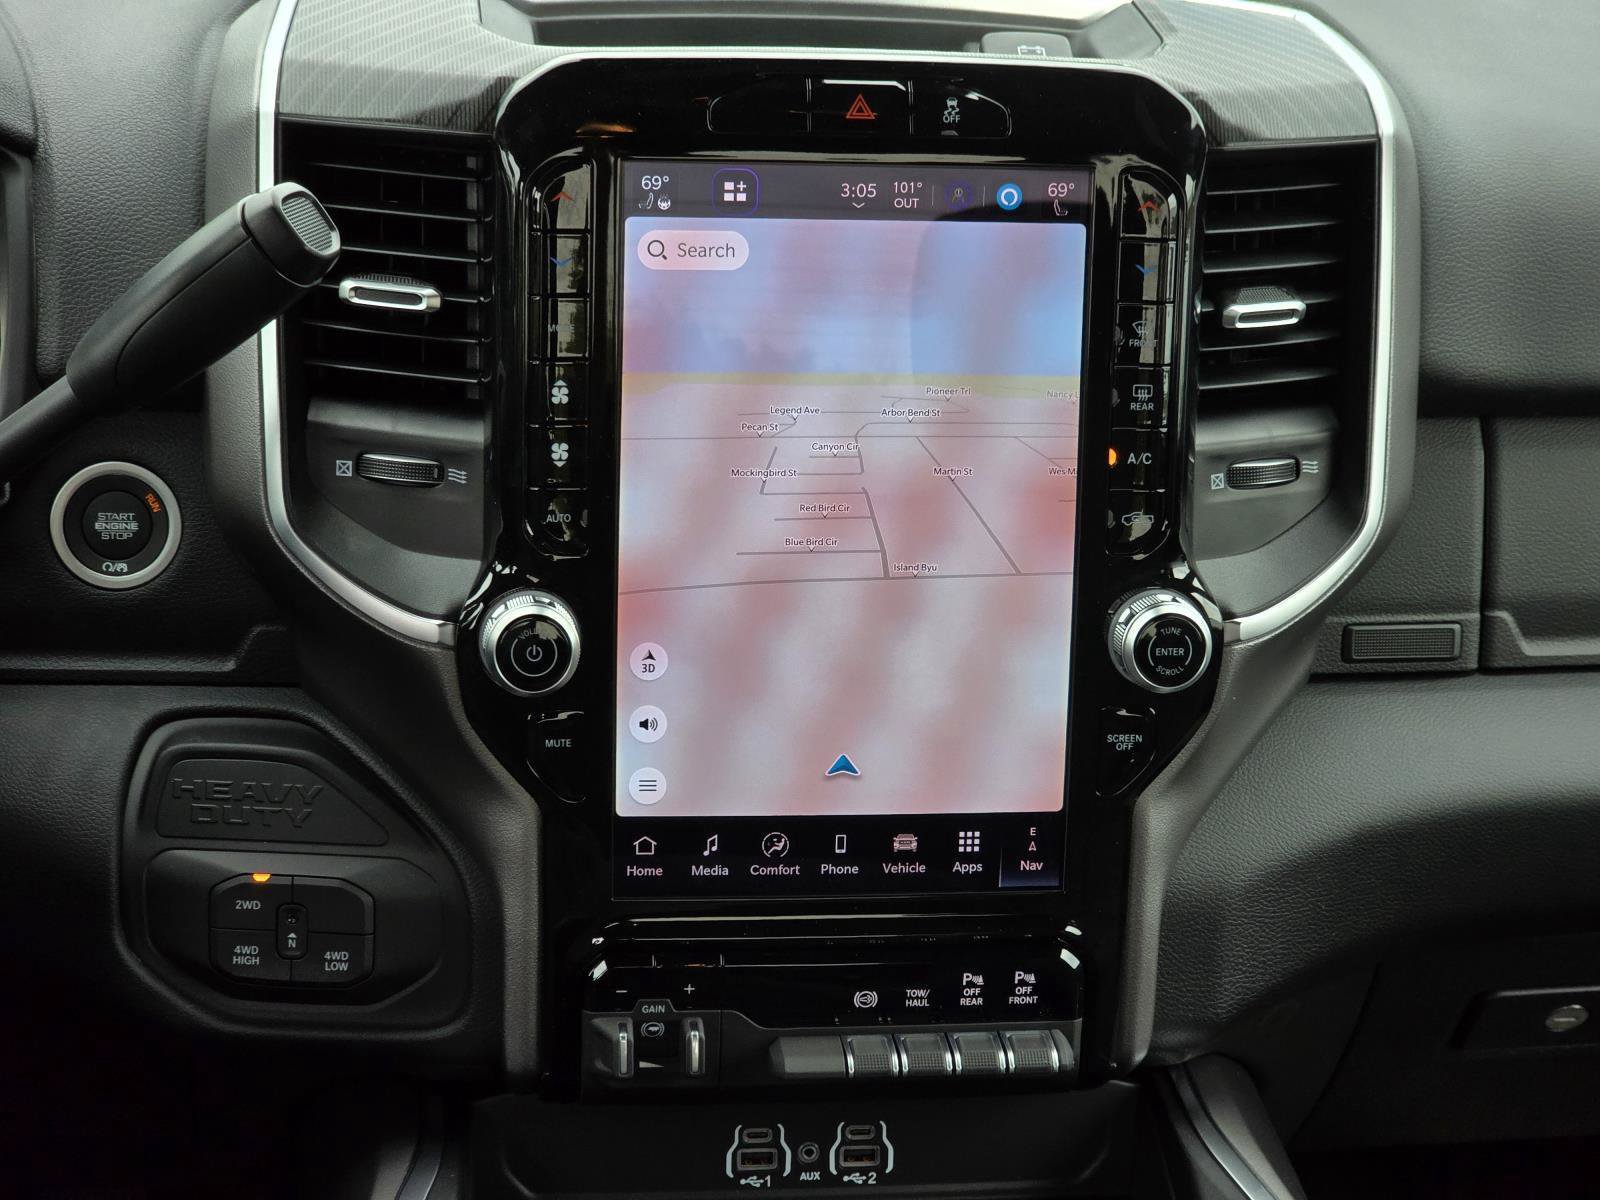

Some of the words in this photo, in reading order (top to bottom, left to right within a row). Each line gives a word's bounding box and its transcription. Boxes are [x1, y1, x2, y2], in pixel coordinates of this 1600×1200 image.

[943, 115, 960, 123] OFF
[642, 176, 669, 190] 69°
[840, 183, 877, 198] 3:05
[1048, 183, 1075, 197] 69°
[894, 198, 919, 209] OUT
[677, 243, 735, 258] Search
[926, 387, 958, 395] Pioneer
[1047, 390, 1073, 400] Nancy
[770, 406, 802, 415] Legend
[804, 406, 820, 414] Ave
[1130, 402, 1154, 411] REAR
[741, 423, 767, 431] Pecan
[770, 423, 778, 431] St
[812, 443, 844, 451] Canyon
[1127, 453, 1152, 465] A/C
[731, 469, 786, 478] Mockingbird
[788, 469, 797, 477] St
[934, 467, 962, 475] Martin
[964, 467, 972, 475] St
[145, 493, 161, 513] RUN
[800, 504, 816, 512] Red
[818, 504, 836, 512] Bird
[838, 504, 850, 512] Cir
[98, 512, 135, 521] START
[546, 513, 571, 523] AUTO
[785, 538, 804, 546] Blue
[806, 538, 824, 546] Bird
[826, 538, 838, 546] Cir
[922, 564, 937, 572] Byu
[1160, 626, 1182, 636] TUNE
[1156, 648, 1185, 656] ENTER
[642, 663, 656, 673] 3D
[1156, 665, 1184, 676] SCROLL
[545, 739, 572, 747] MUTE
[1107, 734, 1142, 742] SCREEN
[171, 778, 323, 804] HEAVY
[190, 804, 313, 827] DUTY
[1030, 827, 1037, 836] E
[691, 864, 729, 876] Media
[750, 863, 800, 876] Comfort
[821, 863, 859, 875] Phone
[882, 862, 926, 874] Vehicle
[952, 861, 983, 875] Apps
[1020, 860, 1043, 870] Nav
[626, 865, 663, 876] Home
[235, 900, 260, 910] 2WD
[288, 938, 296, 948] N
[234, 946, 259, 955] 4WD
[233, 955, 259, 965] HIGH
[324, 952, 349, 961] 4WD
[325, 961, 349, 971] LOW
[906, 989, 931, 998] TOW/
[964, 988, 980, 996] OFF
[1016, 986, 1032, 995] OFF
[906, 998, 930, 1007] HAUL
[960, 998, 983, 1006] REAR
[1009, 996, 1038, 1004] FRONT
[642, 1005, 665, 1014] GAIN
[765, 1175, 771, 1187] 1
[800, 1172, 821, 1181] AUX
[868, 1172, 877, 1184] 2
